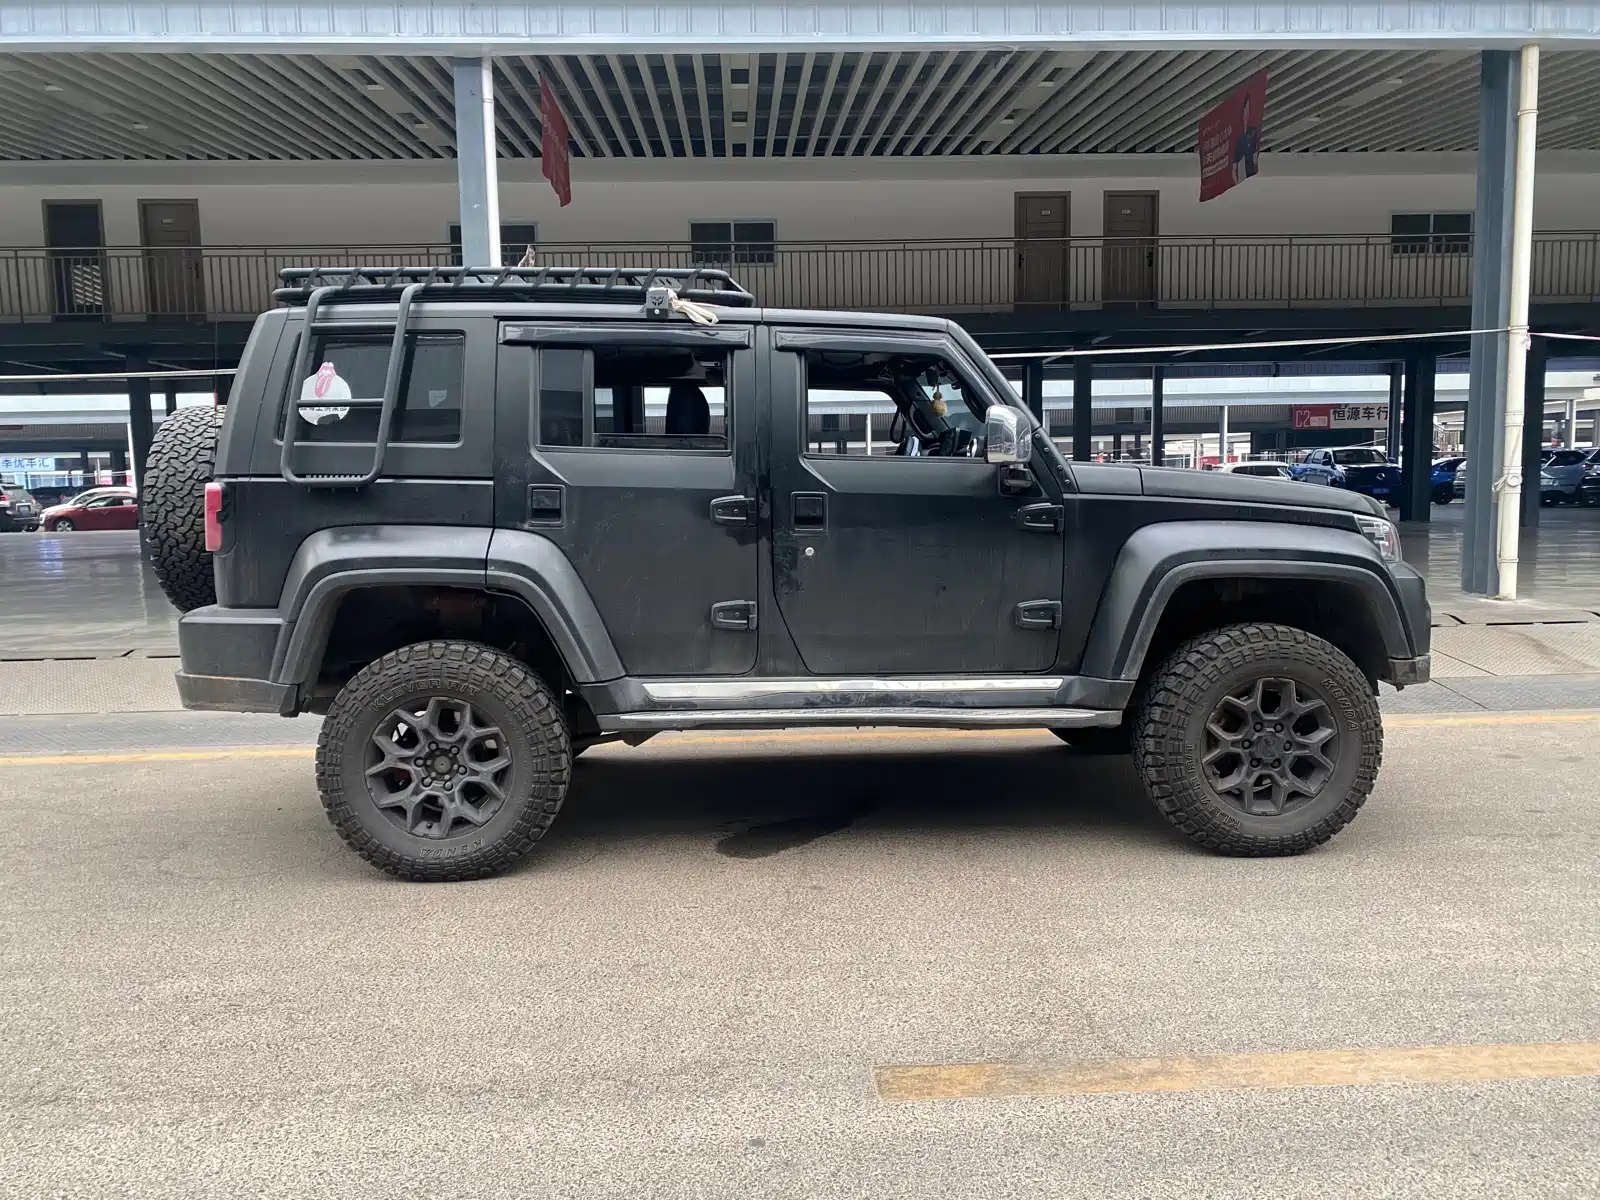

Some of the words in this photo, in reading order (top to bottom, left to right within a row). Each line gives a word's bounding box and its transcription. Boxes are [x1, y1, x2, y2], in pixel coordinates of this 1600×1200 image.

[1295, 410, 1310, 428] C2
[1332, 406, 1388, 421] 恒源车行
[370, 679, 441, 712] KLEVER
[1321, 678, 1358, 731] KENDA
[420, 838, 485, 858] KENDA
